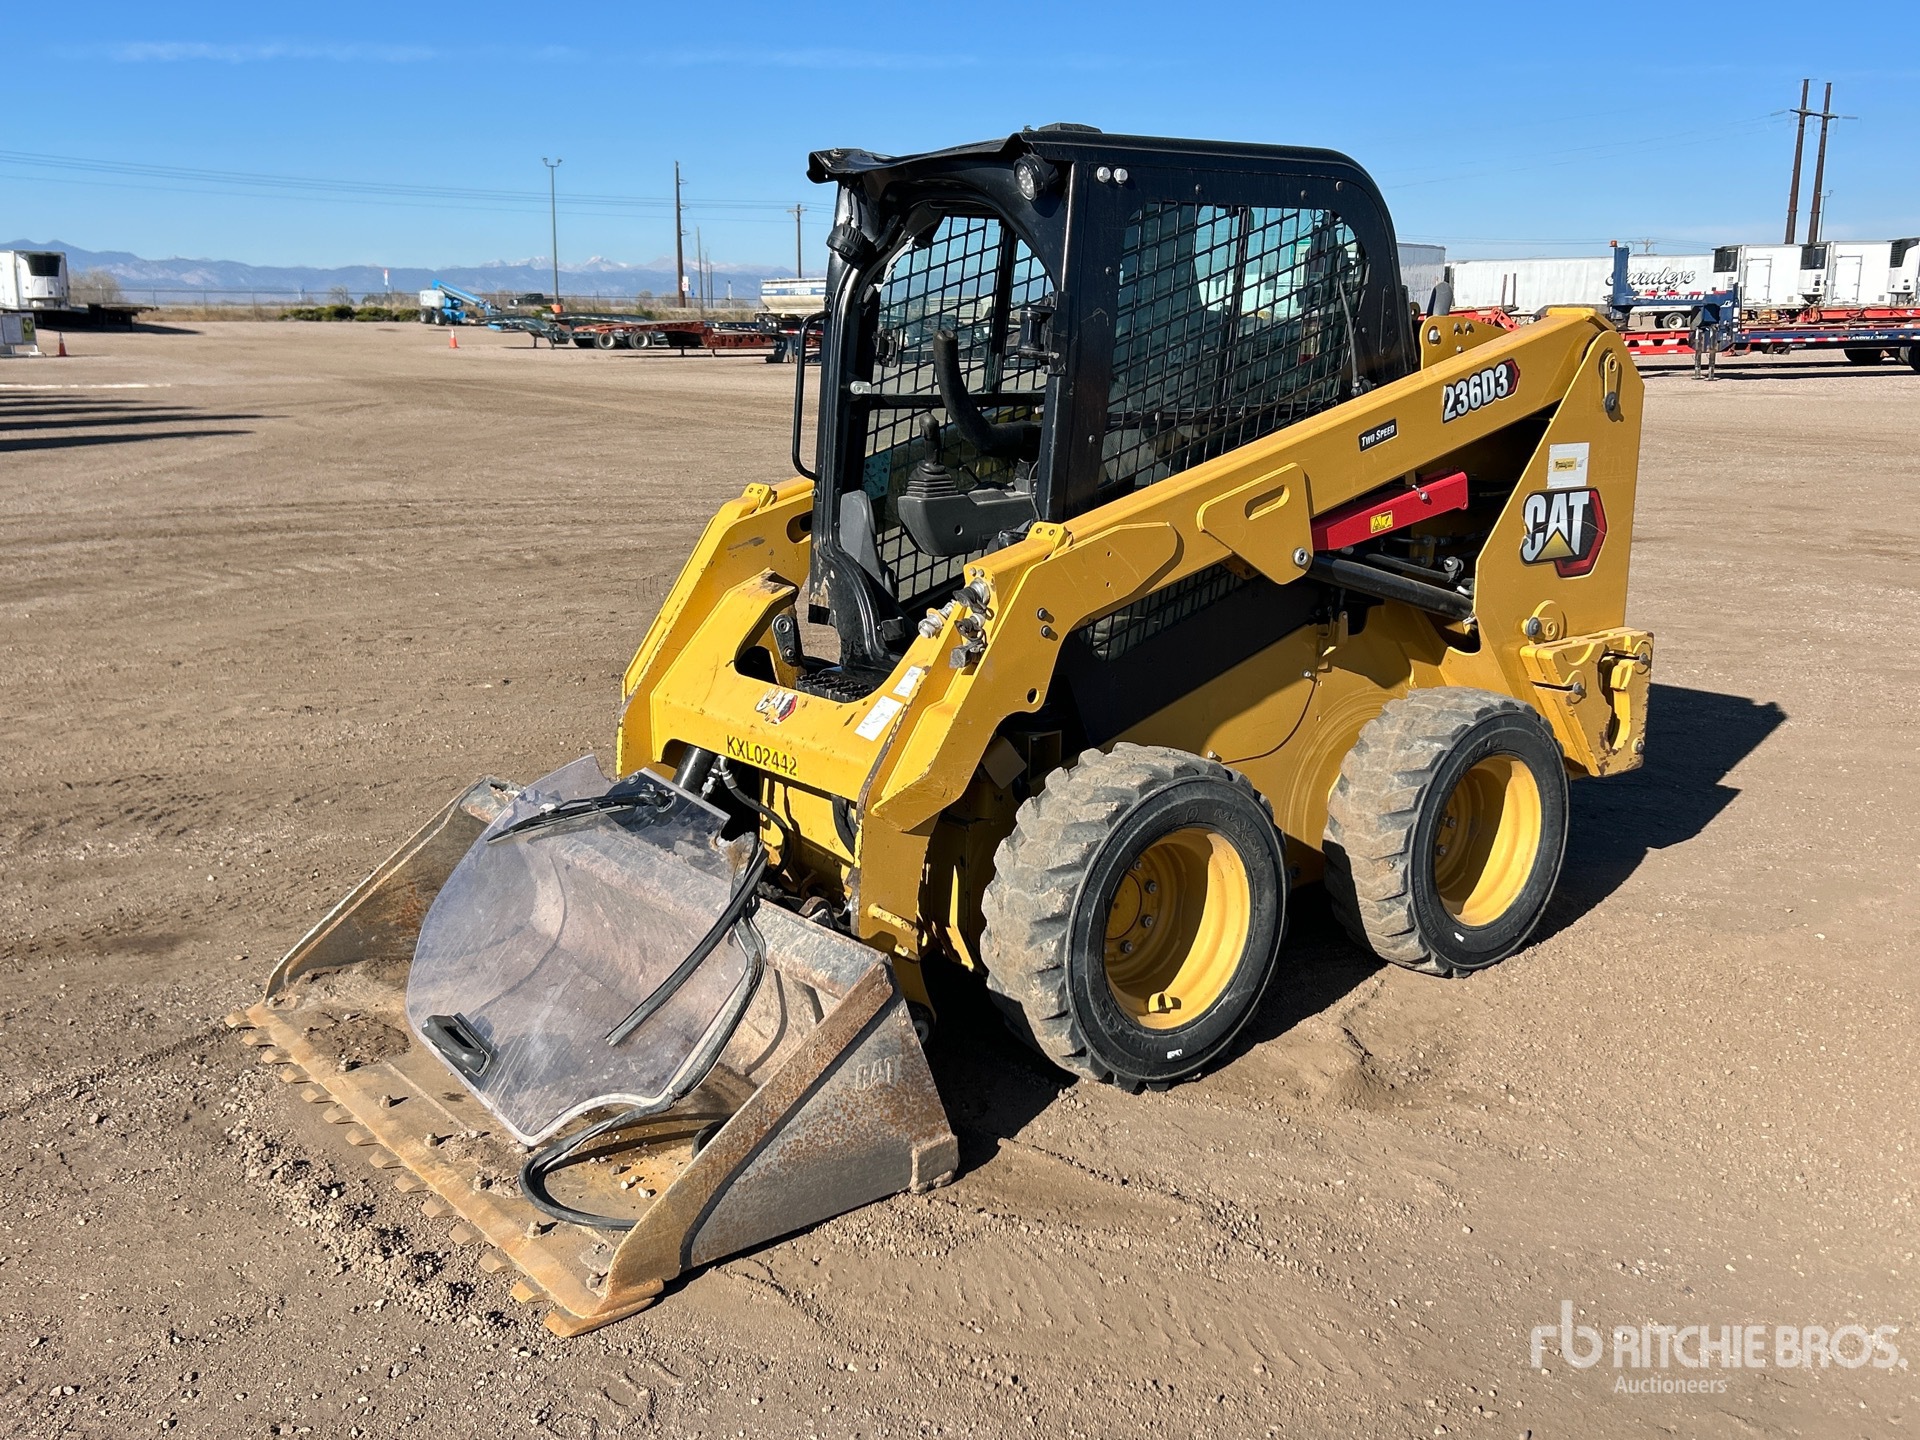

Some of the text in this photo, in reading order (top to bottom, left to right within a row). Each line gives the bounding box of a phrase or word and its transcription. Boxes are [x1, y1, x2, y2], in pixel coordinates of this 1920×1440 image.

[1605, 267, 1696, 289] urnleys
[1443, 363, 1508, 421] 236D3
[1522, 491, 1590, 562] CAT
[755, 688, 795, 716] CAT
[726, 734, 798, 777] KXL02442
